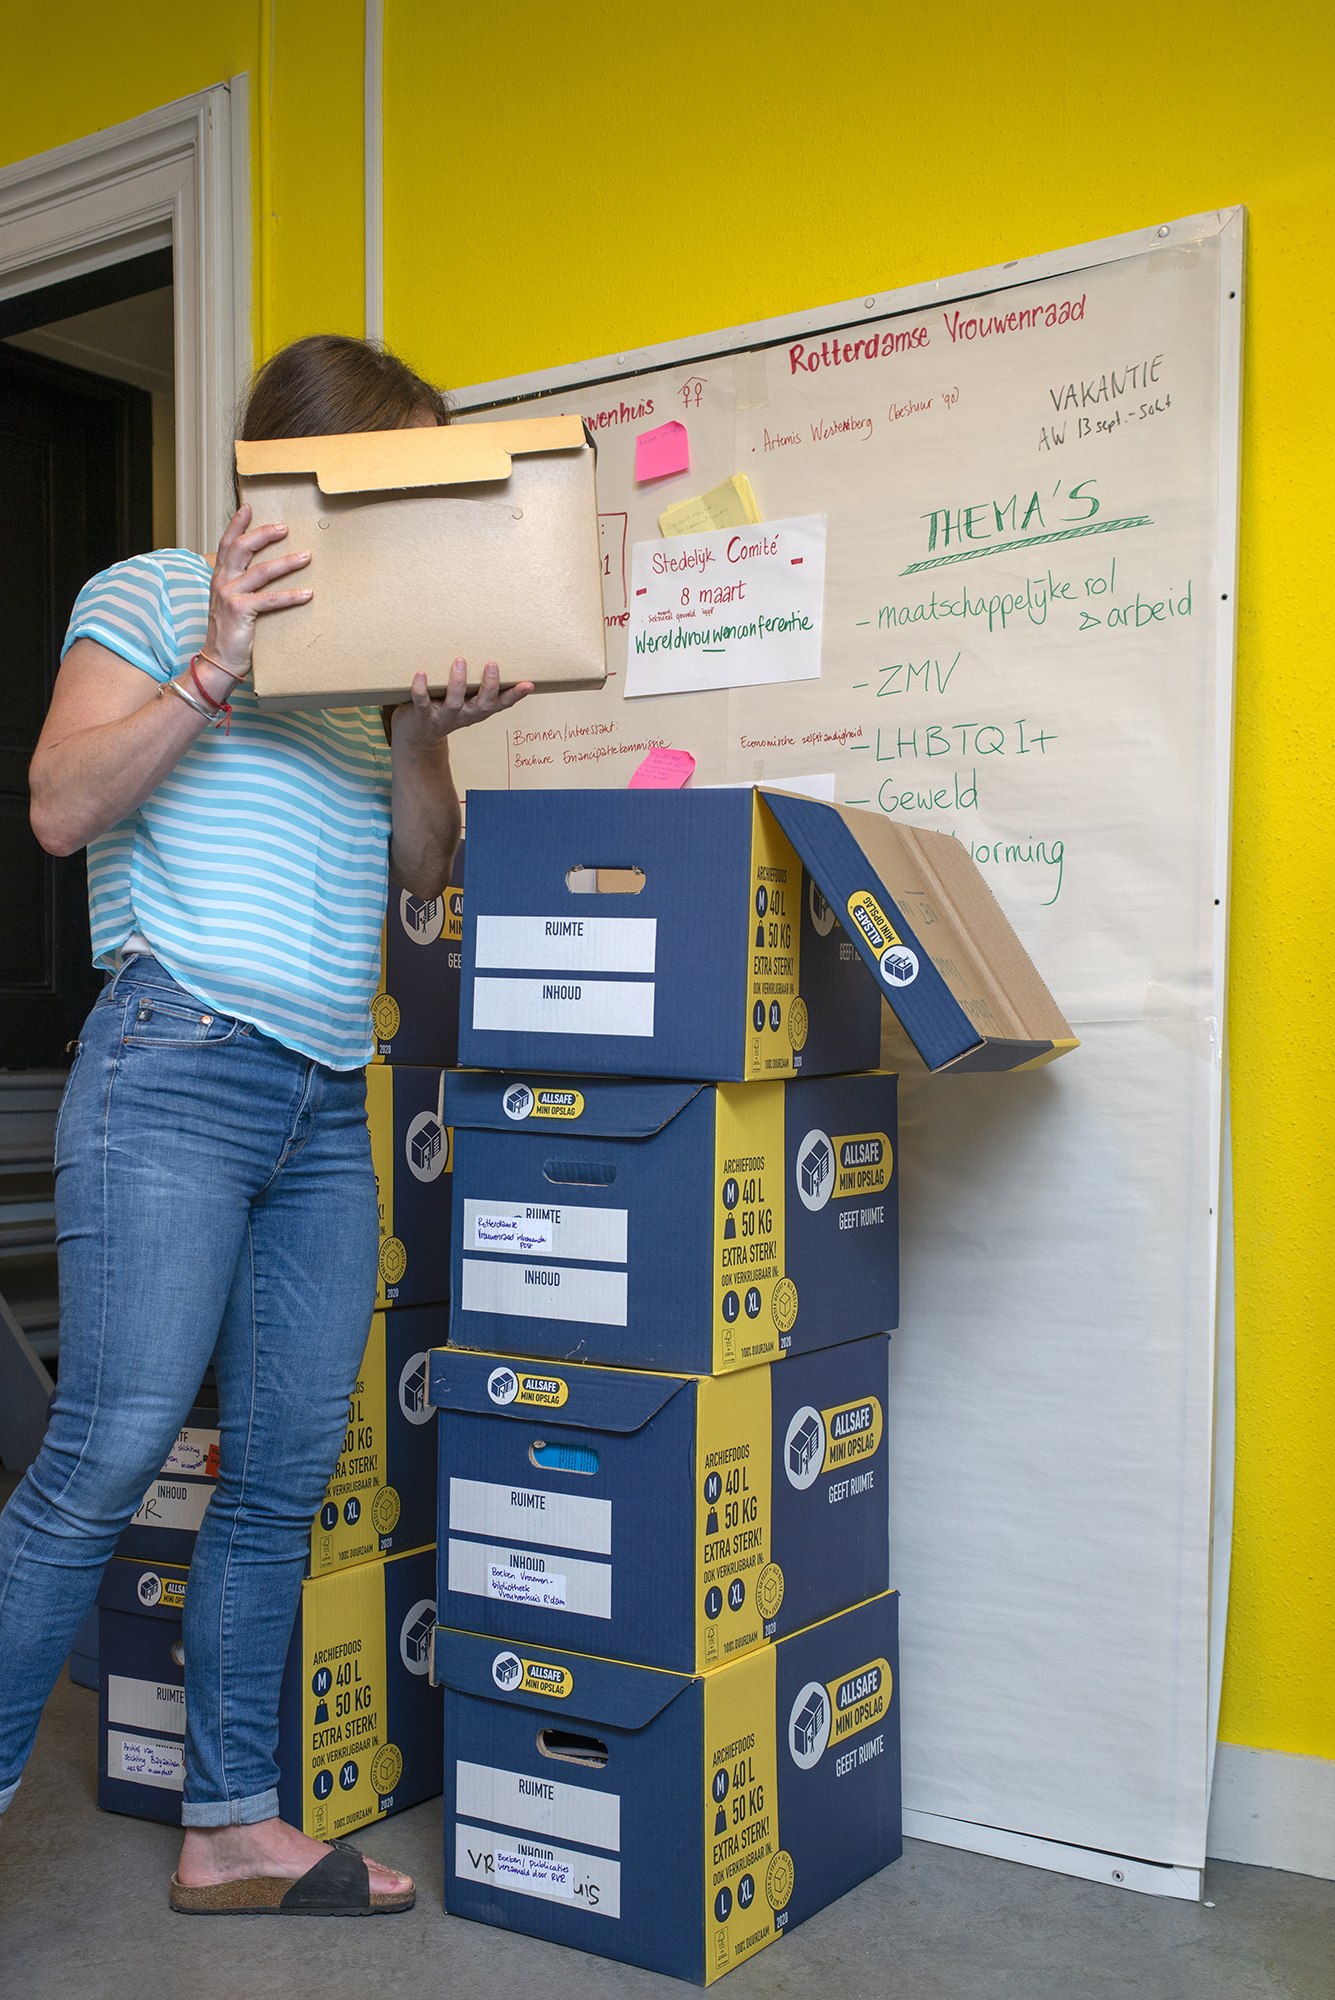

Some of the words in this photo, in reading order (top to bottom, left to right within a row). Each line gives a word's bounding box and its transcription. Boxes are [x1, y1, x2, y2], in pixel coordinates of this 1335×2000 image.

[789, 326, 931, 376] Rotterdamse
[944, 294, 1087, 344] Vrouwenraad
[1050, 353, 1164, 412] VAKANTIE
[585, 398, 655, 431] wenhuis
[764, 428, 802, 452] Artemis
[1038, 420, 1067, 451] AW
[1078, 418, 1092, 439] 13
[920, 479, 1100, 552] THEMA'S
[651, 547, 716, 574] Stedelijk
[726, 533, 780, 564] Comité
[1084, 556, 1116, 595] rol
[680, 587, 690, 606] 8
[699, 580, 747, 604] maart
[1107, 579, 1192, 628] arbeid
[635, 611, 814, 654] Wereldvrouwenconferentie
[877, 651, 961, 697] ZMV
[740, 735, 796, 748] Economische
[802, 725, 863, 746] zelfstandigheid
[876, 719, 1058, 762] LHBTQI+
[515, 753, 555, 768] Brochure
[879, 768, 978, 812] Geweld
[757, 866, 787, 884] ARCHIEFDOOS
[770, 890, 780, 916] 40
[862, 897, 885, 926] OPSLAG
[545, 921, 584, 937] RUIMTE
[768, 922, 778, 949] 50
[780, 923, 791, 949] KG
[854, 907, 883, 945] ALLSAFE
[880, 924, 895, 943] MINI
[754, 956, 772, 976] EXTRA
[773, 956, 794, 976] STERK!
[542, 984, 582, 1000] INHOUD
[771, 1005, 780, 1030] XL
[536, 1106, 550, 1115] MINI
[552, 1107, 576, 1116] OPSLAG
[541, 1093, 573, 1105] ALLSAFE
[723, 1156, 765, 1174] ARCHIEFDOOS
[844, 1141, 880, 1165] ALLSAFE
[727, 1183, 735, 1203] M
[742, 1178, 755, 1205] 40
[758, 1177, 764, 1203] L
[839, 1172, 855, 1191] MINI
[857, 1168, 885, 1188] OPSLAG
[741, 1211, 755, 1237] 50
[758, 1208, 772, 1234] KG
[839, 1208, 859, 1231] GEEFT
[860, 1205, 885, 1226] RUIMTE
[722, 1245, 748, 1268] EXTRA
[749, 1240, 777, 1263] STERK!
[525, 1270, 560, 1286] INHOUD
[721, 1273, 733, 1287] OOK
[733, 1267, 772, 1285] VERKRIJGBAAR
[728, 1296, 735, 1316] L
[748, 1292, 759, 1312] XL
[780, 1336, 792, 1349] 2020
[520, 1391, 535, 1402] MINI
[536, 1393, 560, 1405] OPSLAG
[525, 1378, 557, 1393] ALLSAFE
[834, 1407, 870, 1437] ALLSAFE
[358, 1427, 373, 1450] KG
[829, 1442, 845, 1464] MINI
[847, 1433, 874, 1458] OPSLAG
[349, 1454, 378, 1476] STERK!
[705, 1444, 750, 1469] ARCHIEFDOOS
[157, 1485, 187, 1500] INHOUD
[709, 1477, 717, 1498] M
[725, 1468, 739, 1495] 40
[743, 1466, 749, 1491] L
[828, 1480, 849, 1504] GEEFT
[850, 1471, 874, 1495] RUIMTE
[347, 1502, 358, 1520] XL
[511, 1491, 546, 1510] RUIMTE
[725, 1501, 739, 1529] 50
[742, 1496, 757, 1524] KG
[704, 1537, 731, 1564] EXTRA
[733, 1527, 762, 1556] STERK!
[510, 1554, 545, 1573] INHOUD
[703, 1569, 716, 1583] OOK
[716, 1557, 757, 1579] VERKRIJGBAAR
[711, 1593, 717, 1612] L
[731, 1583, 742, 1605] XL
[765, 1622, 777, 1636] 2020
[313, 1639, 362, 1666] ARCHIEFDOOS
[318, 1672, 326, 1691] M
[336, 1662, 350, 1688] 40
[354, 1659, 362, 1682] L
[525, 1678, 539, 1690] MINI
[540, 1681, 564, 1695] OPSLAG
[530, 1667, 561, 1682] ALLSAFE
[157, 1687, 184, 1703] RUIMTE
[336, 1691, 350, 1718] 50
[355, 1684, 371, 1712] KG
[840, 1670, 878, 1708] ALLSAFE
[835, 1709, 853, 1736] MINI
[854, 1695, 883, 1728] OPSLAG
[313, 1727, 342, 1750] EXTRA
[345, 1712, 377, 1742] STERK!
[312, 1754, 325, 1768] OOK
[326, 1738, 371, 1764] VERKRIJGBAAR
[712, 1733, 755, 1768] ARCHIEFDOOS
[835, 1747, 857, 1778] GEEFT
[859, 1734, 884, 1768] RUIMTE
[321, 1776, 327, 1794] L
[343, 1765, 355, 1786] XL
[518, 1778, 554, 1801] RUIMTE
[716, 1773, 725, 1796] M
[732, 1760, 746, 1790] 40
[749, 1757, 755, 1783] L
[381, 1796, 394, 1811] 2020
[732, 1794, 745, 1825] 50
[749, 1785, 764, 1815] KG
[713, 1834, 739, 1866] EXTRA
[741, 1816, 770, 1849] STERK!
[713, 1871, 725, 1886] OOK
[725, 1847, 764, 1882] VERKRIJGBAAR
[721, 1894, 727, 1915] L
[741, 1879, 752, 1904] XL
[777, 1912, 789, 1929] 2020
